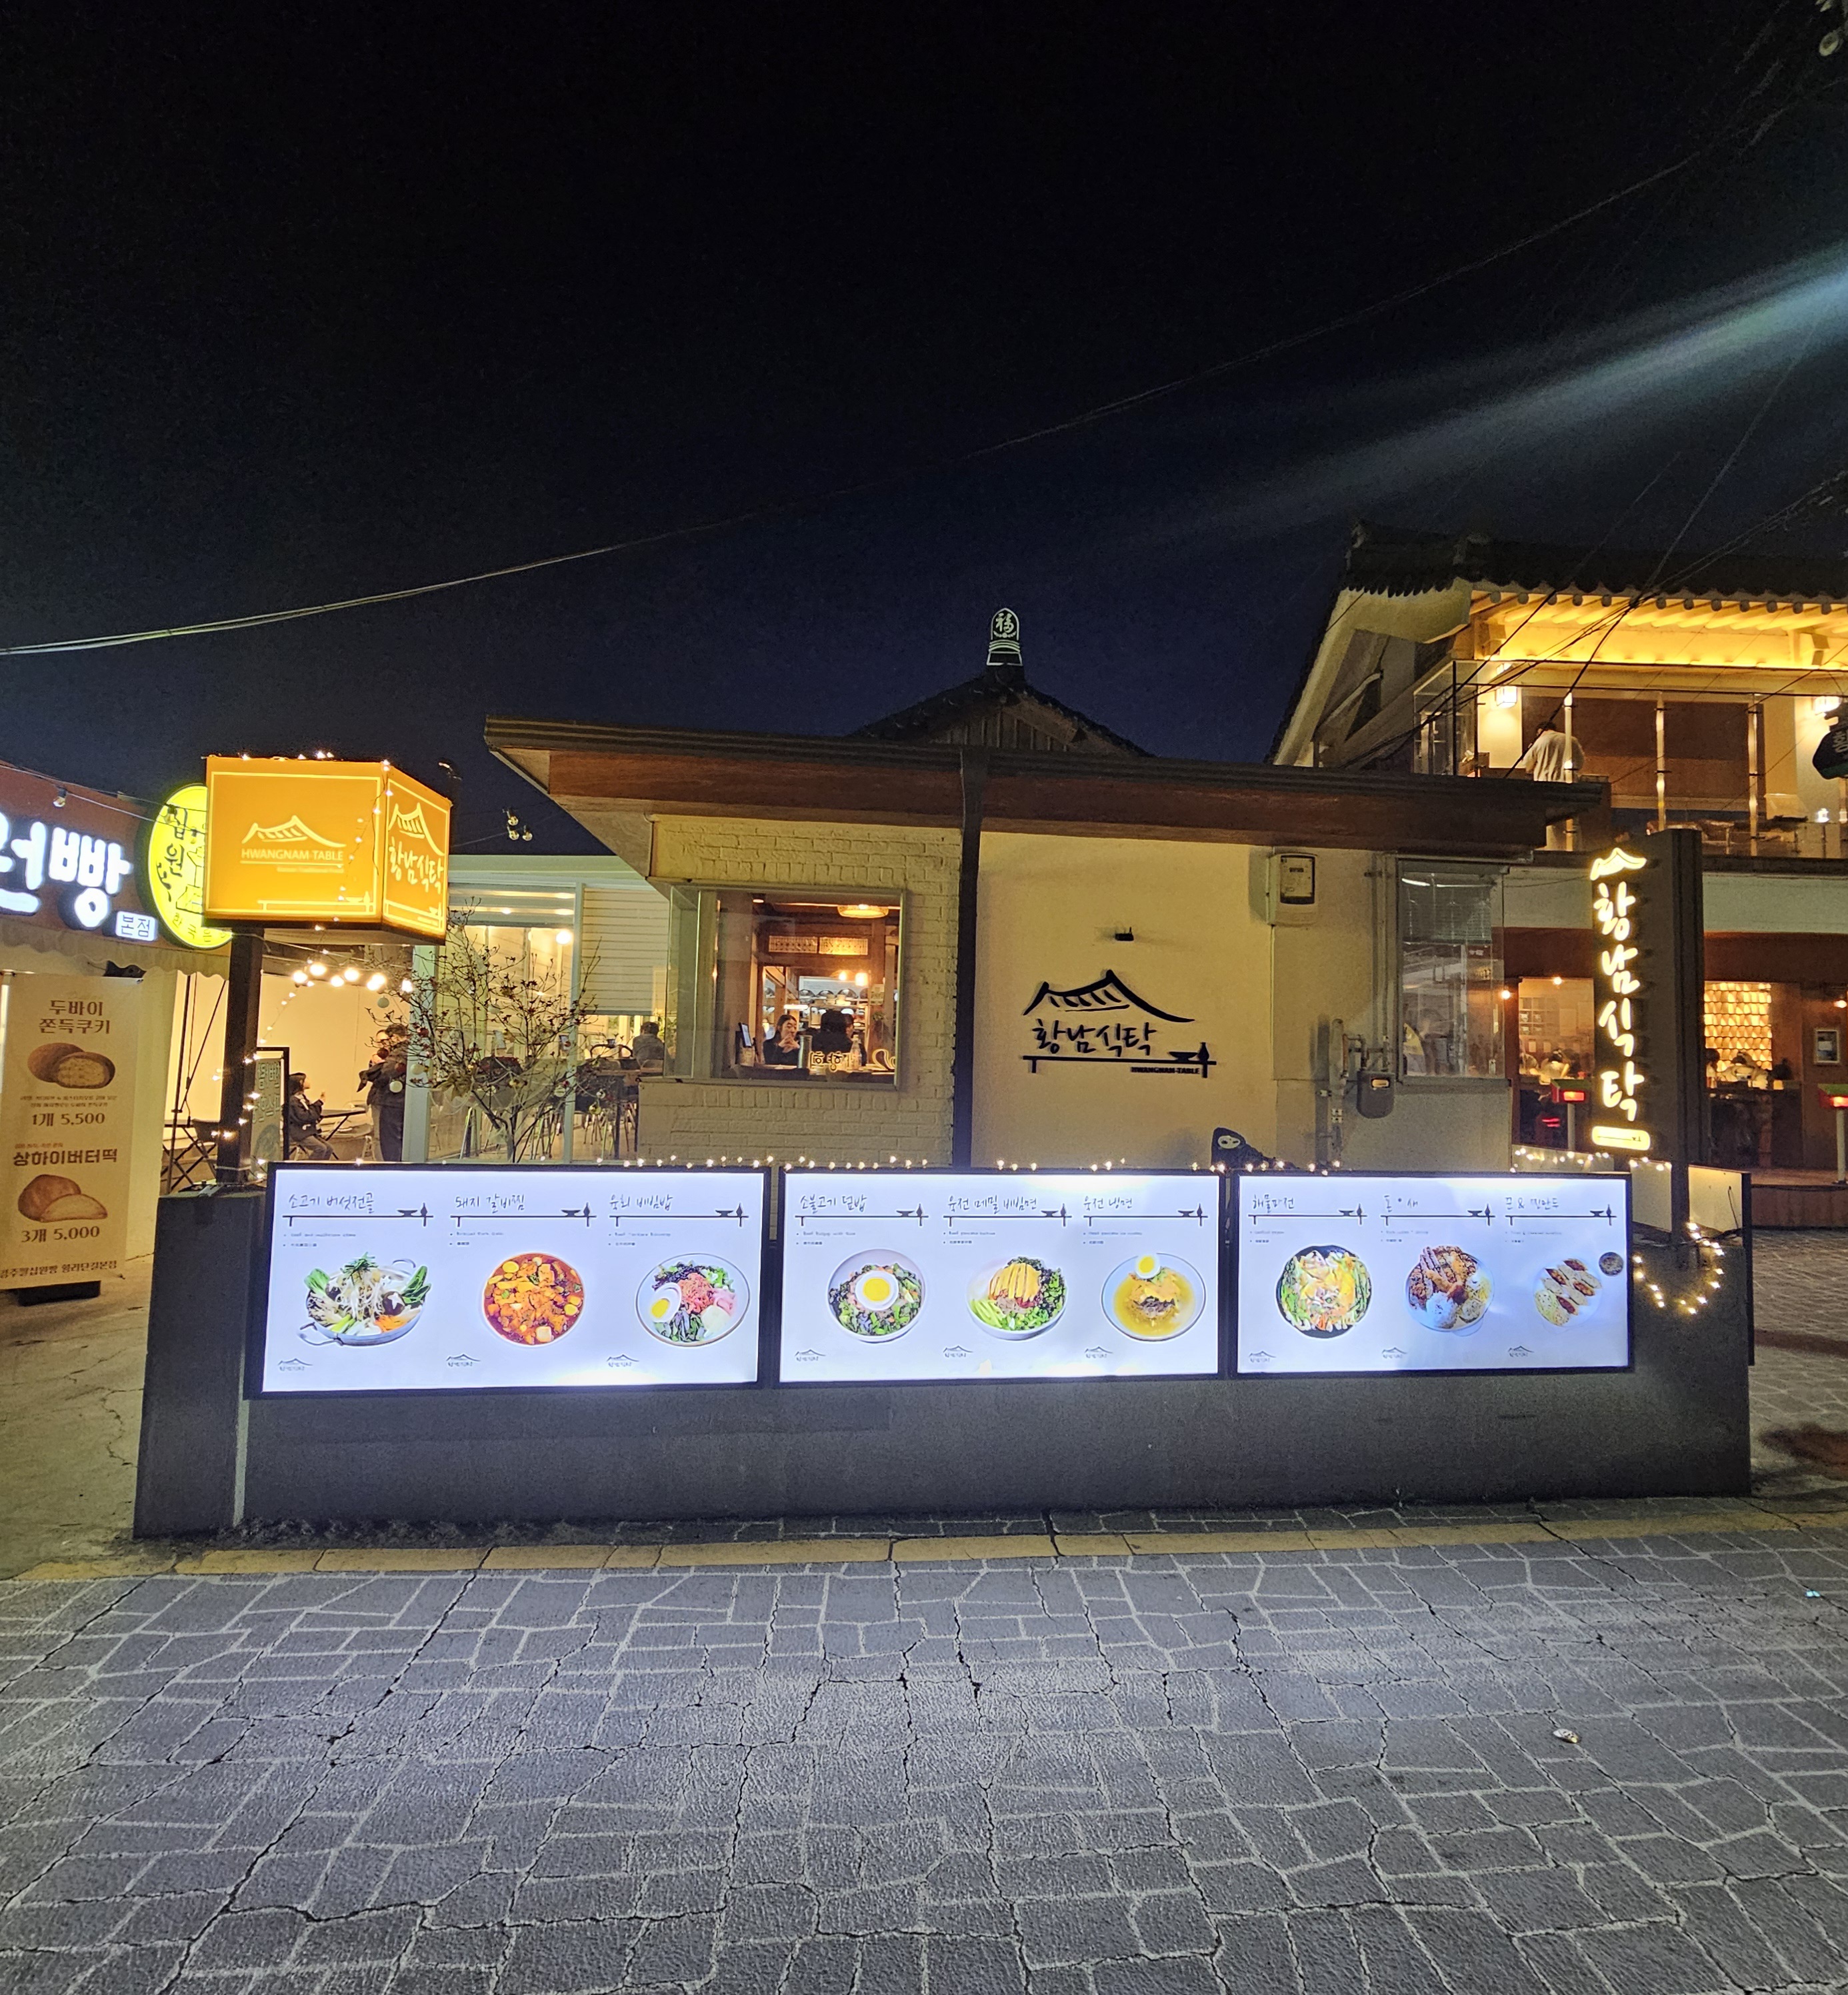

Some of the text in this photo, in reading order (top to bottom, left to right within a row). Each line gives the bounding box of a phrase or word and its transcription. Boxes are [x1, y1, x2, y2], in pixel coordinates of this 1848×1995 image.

[996, 613, 1015, 633] 福
[241, 848, 343, 861] HWANGNAM TABLE
[389, 836, 444, 895] 황남식탁
[121, 914, 151, 938] 본점
[49, 1000, 103, 1016] 두바이
[1593, 881, 1645, 1122] 황남식탁
[39, 1018, 110, 1034] 쫀득쿠키
[1032, 1019, 1157, 1057] 황남식탁
[32, 1114, 53, 1126] 1개
[13, 1148, 117, 1166] 상하이버터떡
[289, 1192, 375, 1214] 소고기 버섯전골
[455, 1193, 525, 1214] 돼지 갈비찜
[636, 1194, 673, 1212] 비빔밥
[800, 1194, 867, 1214] 소불고기 덮밥
[974, 1194, 1000, 1214] 메밀
[1003, 1196, 1037, 1211] 비빔면
[1253, 1194, 1295, 1213] 해물파전
[21, 1229, 47, 1243] 3개
